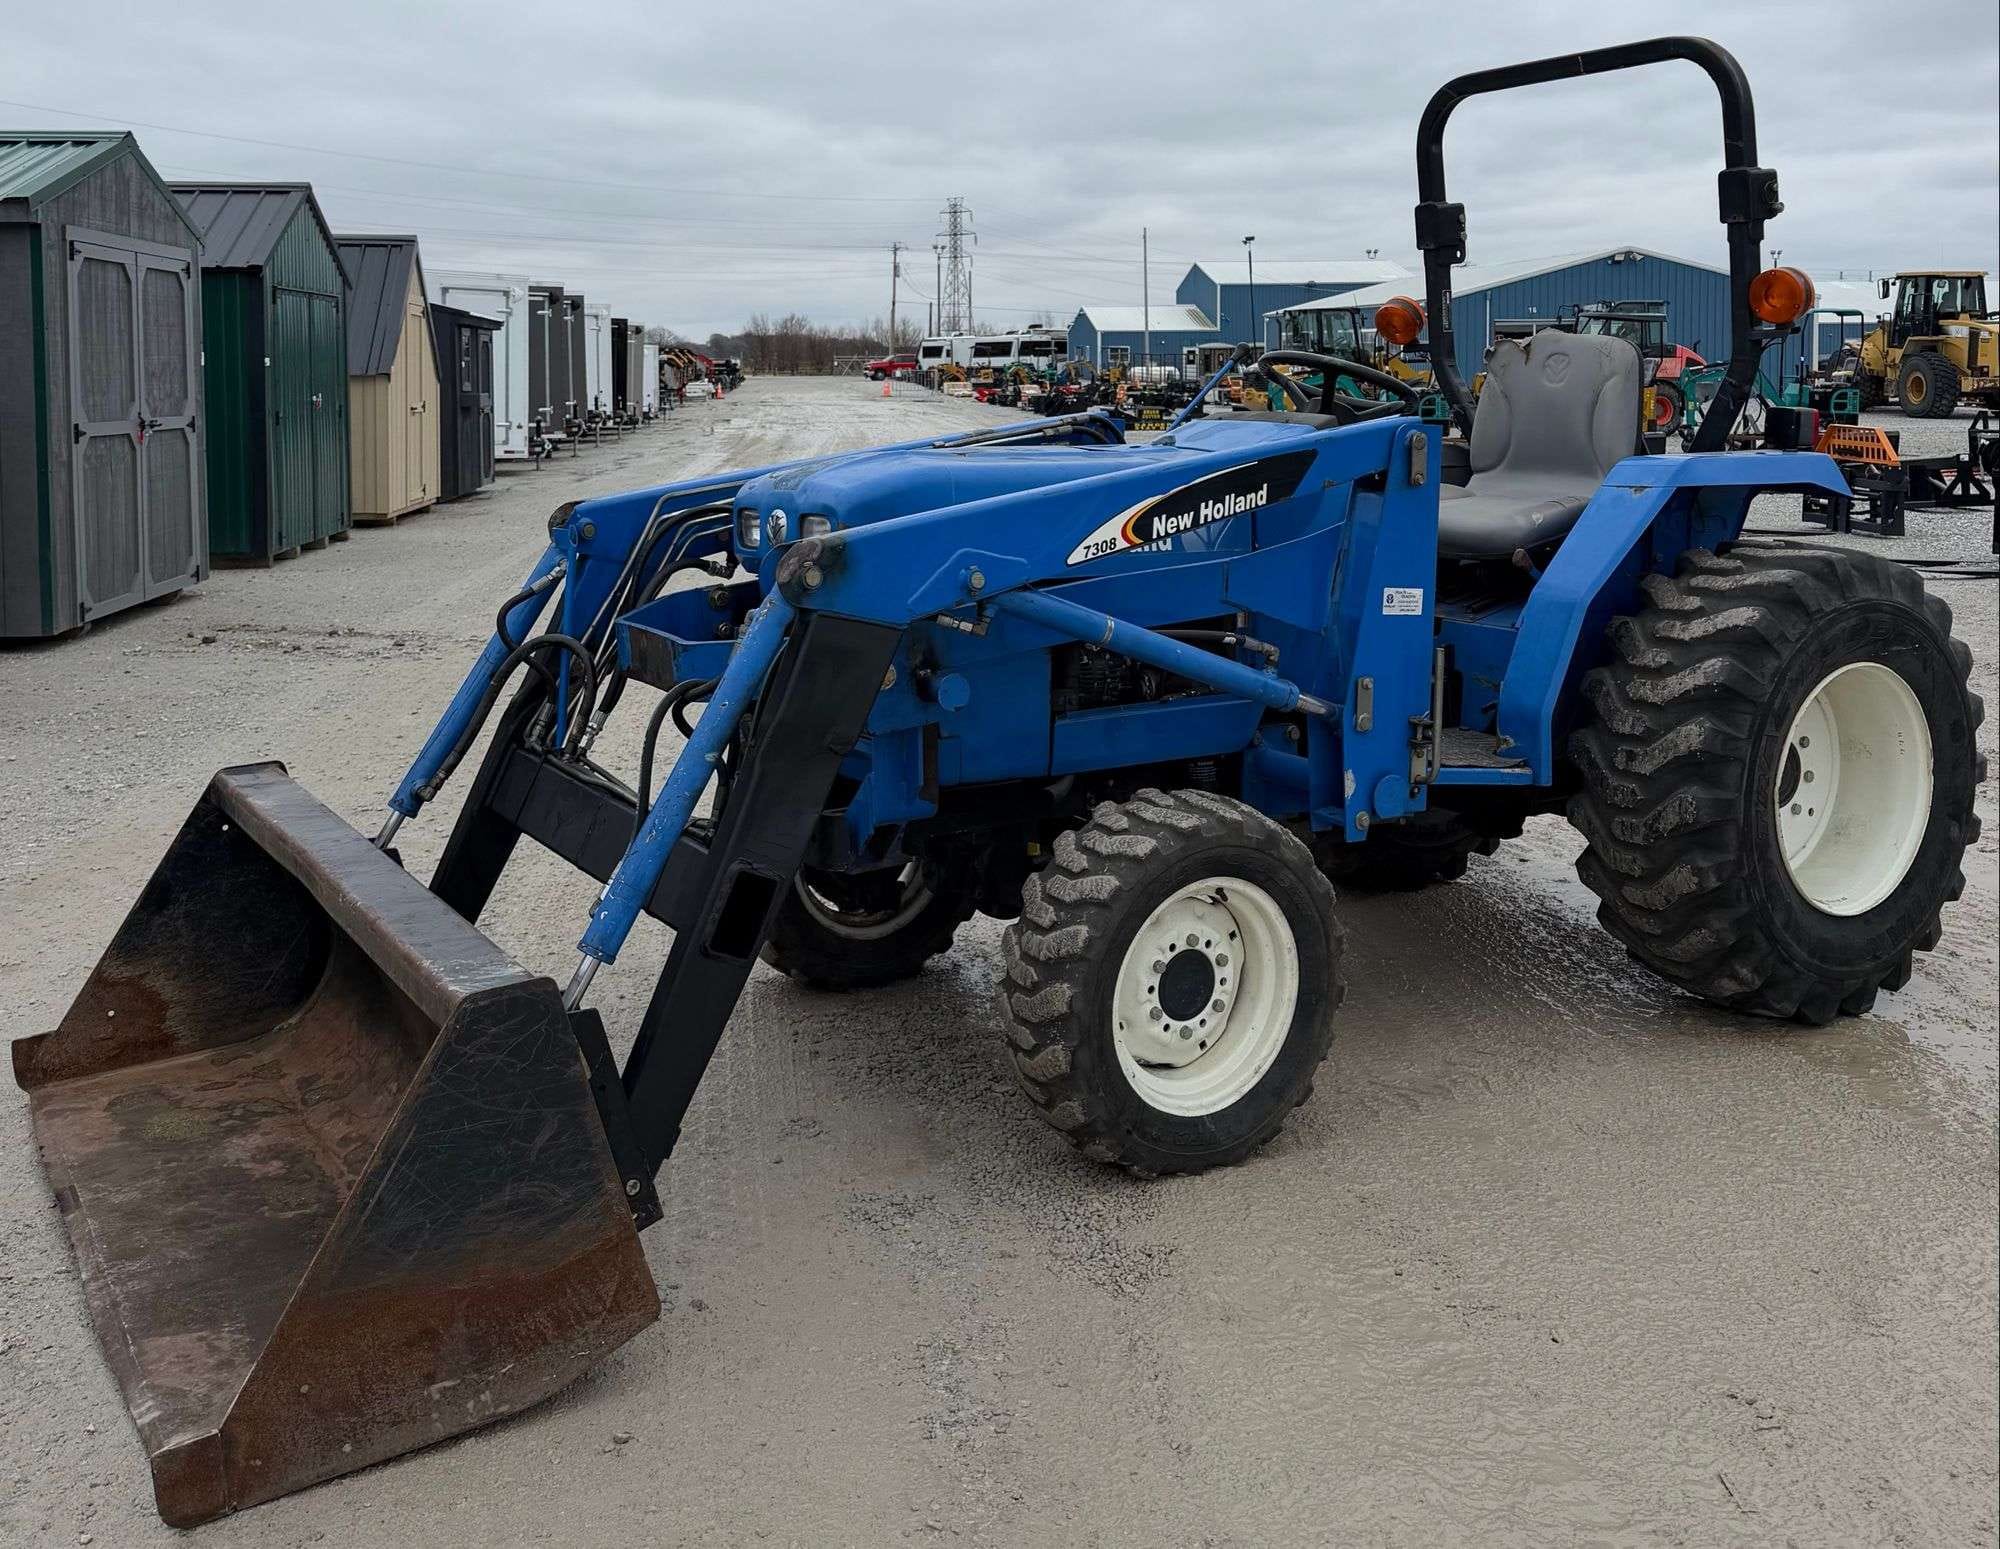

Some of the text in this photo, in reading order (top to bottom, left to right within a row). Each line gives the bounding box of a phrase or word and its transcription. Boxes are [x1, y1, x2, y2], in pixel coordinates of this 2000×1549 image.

[1152, 483, 1268, 539] New Holland
[1083, 537, 1117, 558] 7308
